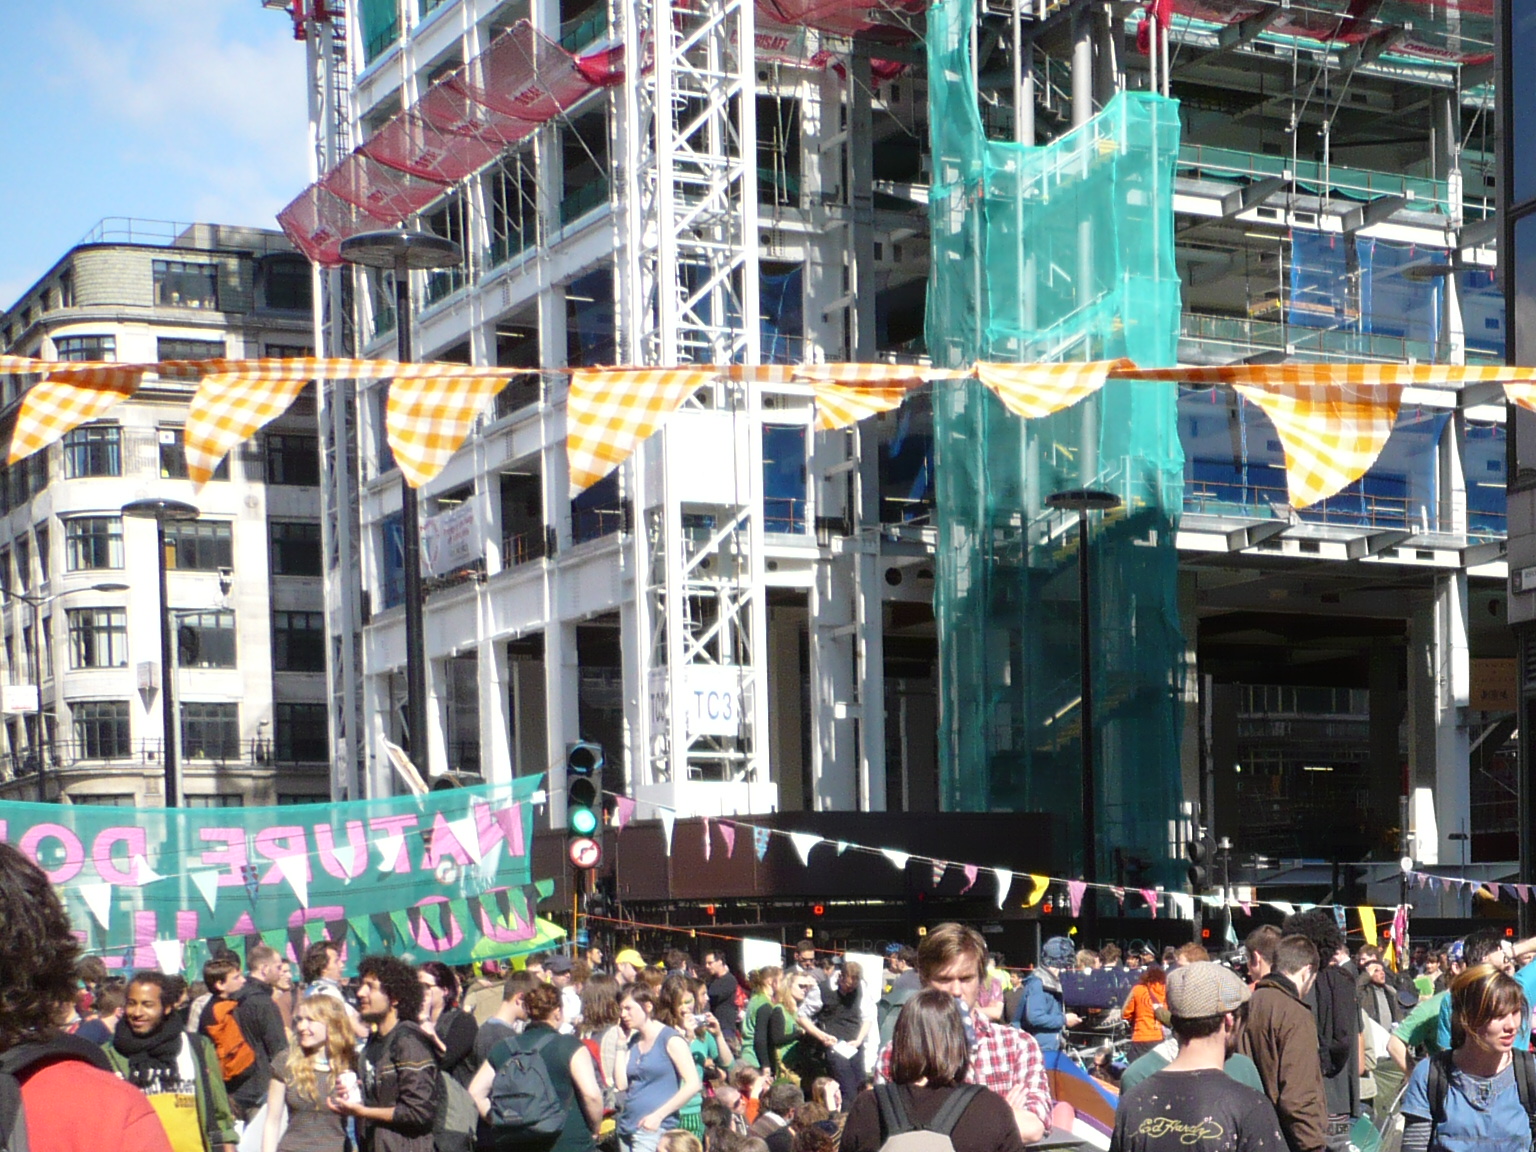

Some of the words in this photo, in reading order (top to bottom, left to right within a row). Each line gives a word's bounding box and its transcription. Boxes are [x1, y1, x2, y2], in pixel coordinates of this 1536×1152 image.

[694, 690, 731, 720] TC3
[1139, 1117, 1163, 1135] Ed
[1162, 1117, 1223, 1145] Hardy
